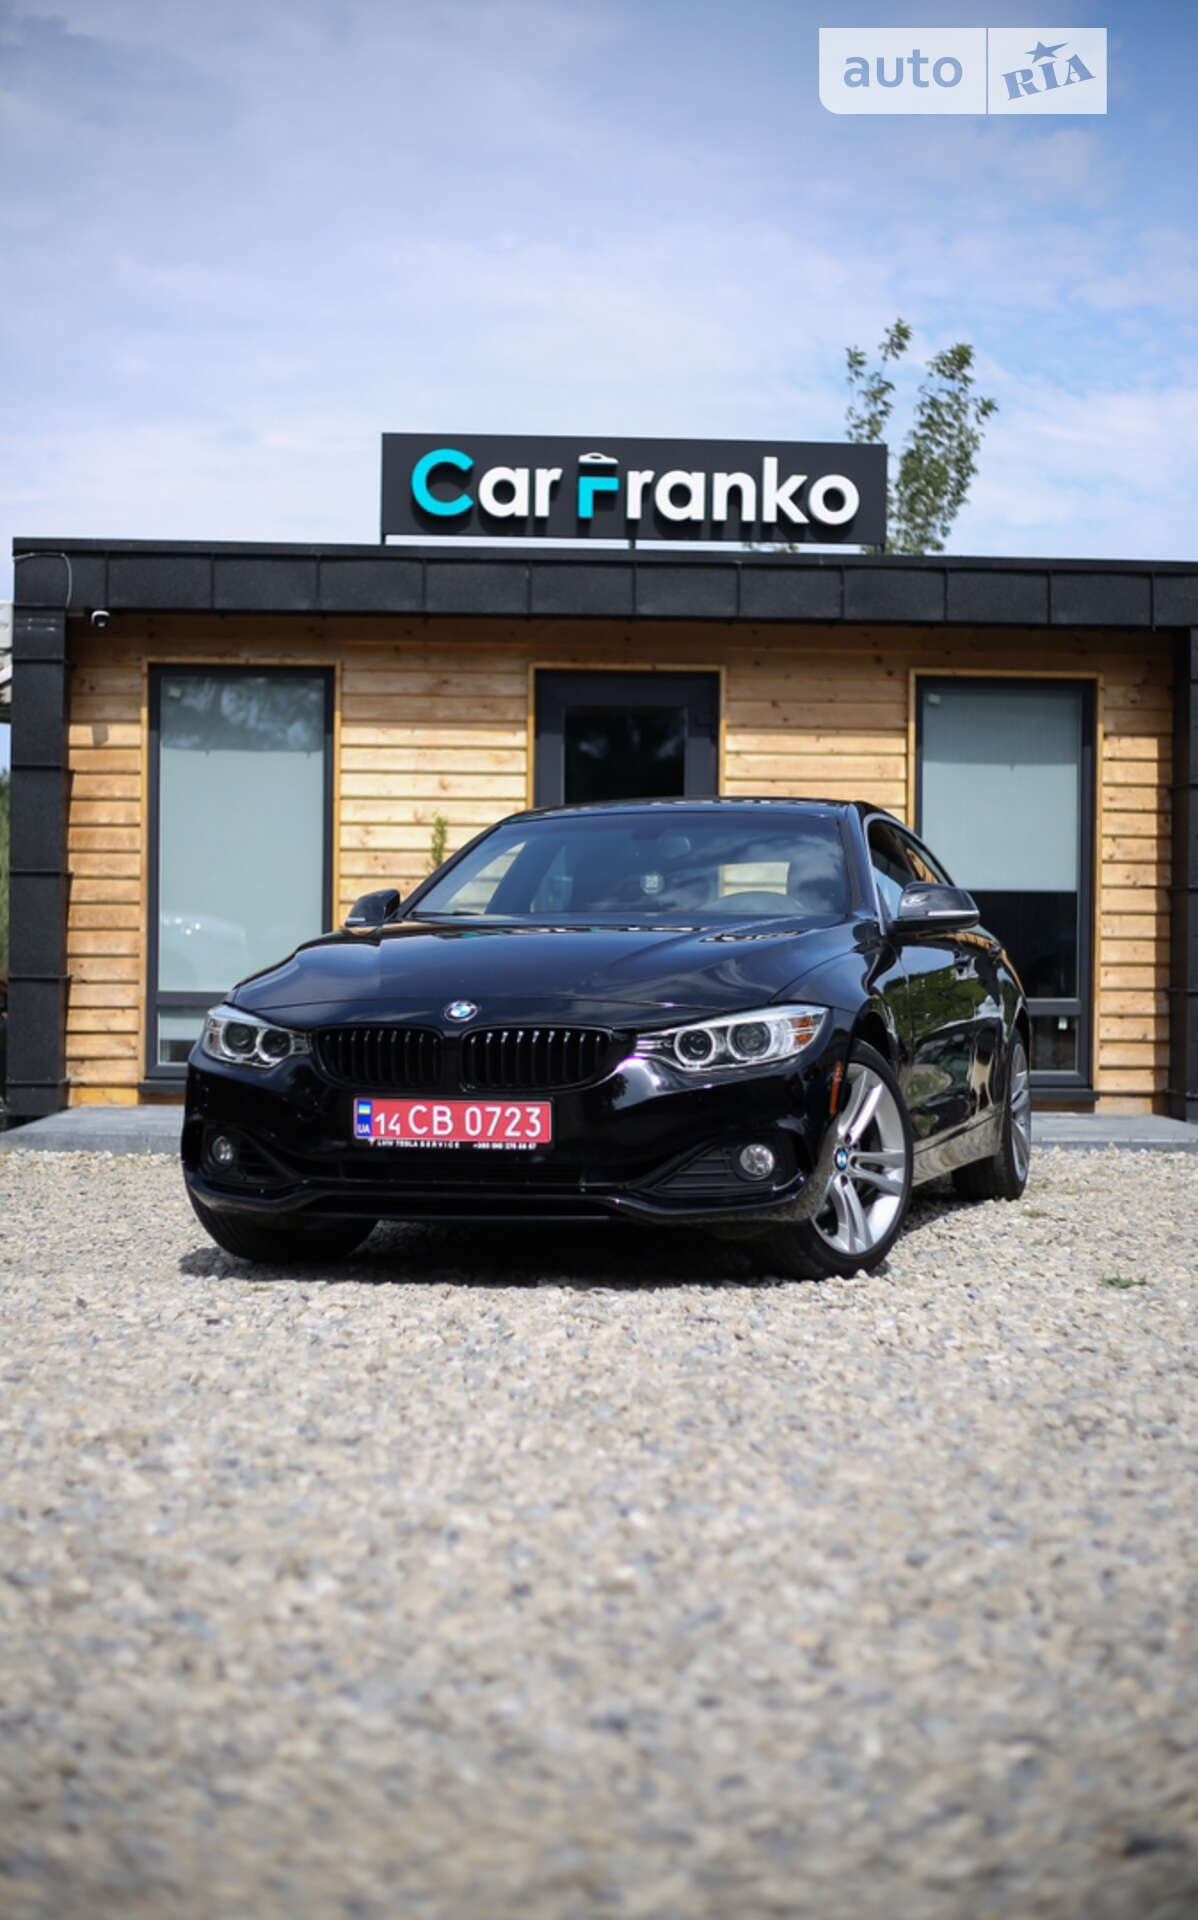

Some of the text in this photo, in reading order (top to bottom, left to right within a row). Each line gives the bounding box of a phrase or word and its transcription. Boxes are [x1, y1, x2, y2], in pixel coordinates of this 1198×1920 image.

[411, 448, 860, 526] Car Franko
[357, 1124, 370, 1134] UA
[375, 1105, 541, 1138] 14 CB 0723
[420, 1141, 460, 1149] SERVICE
